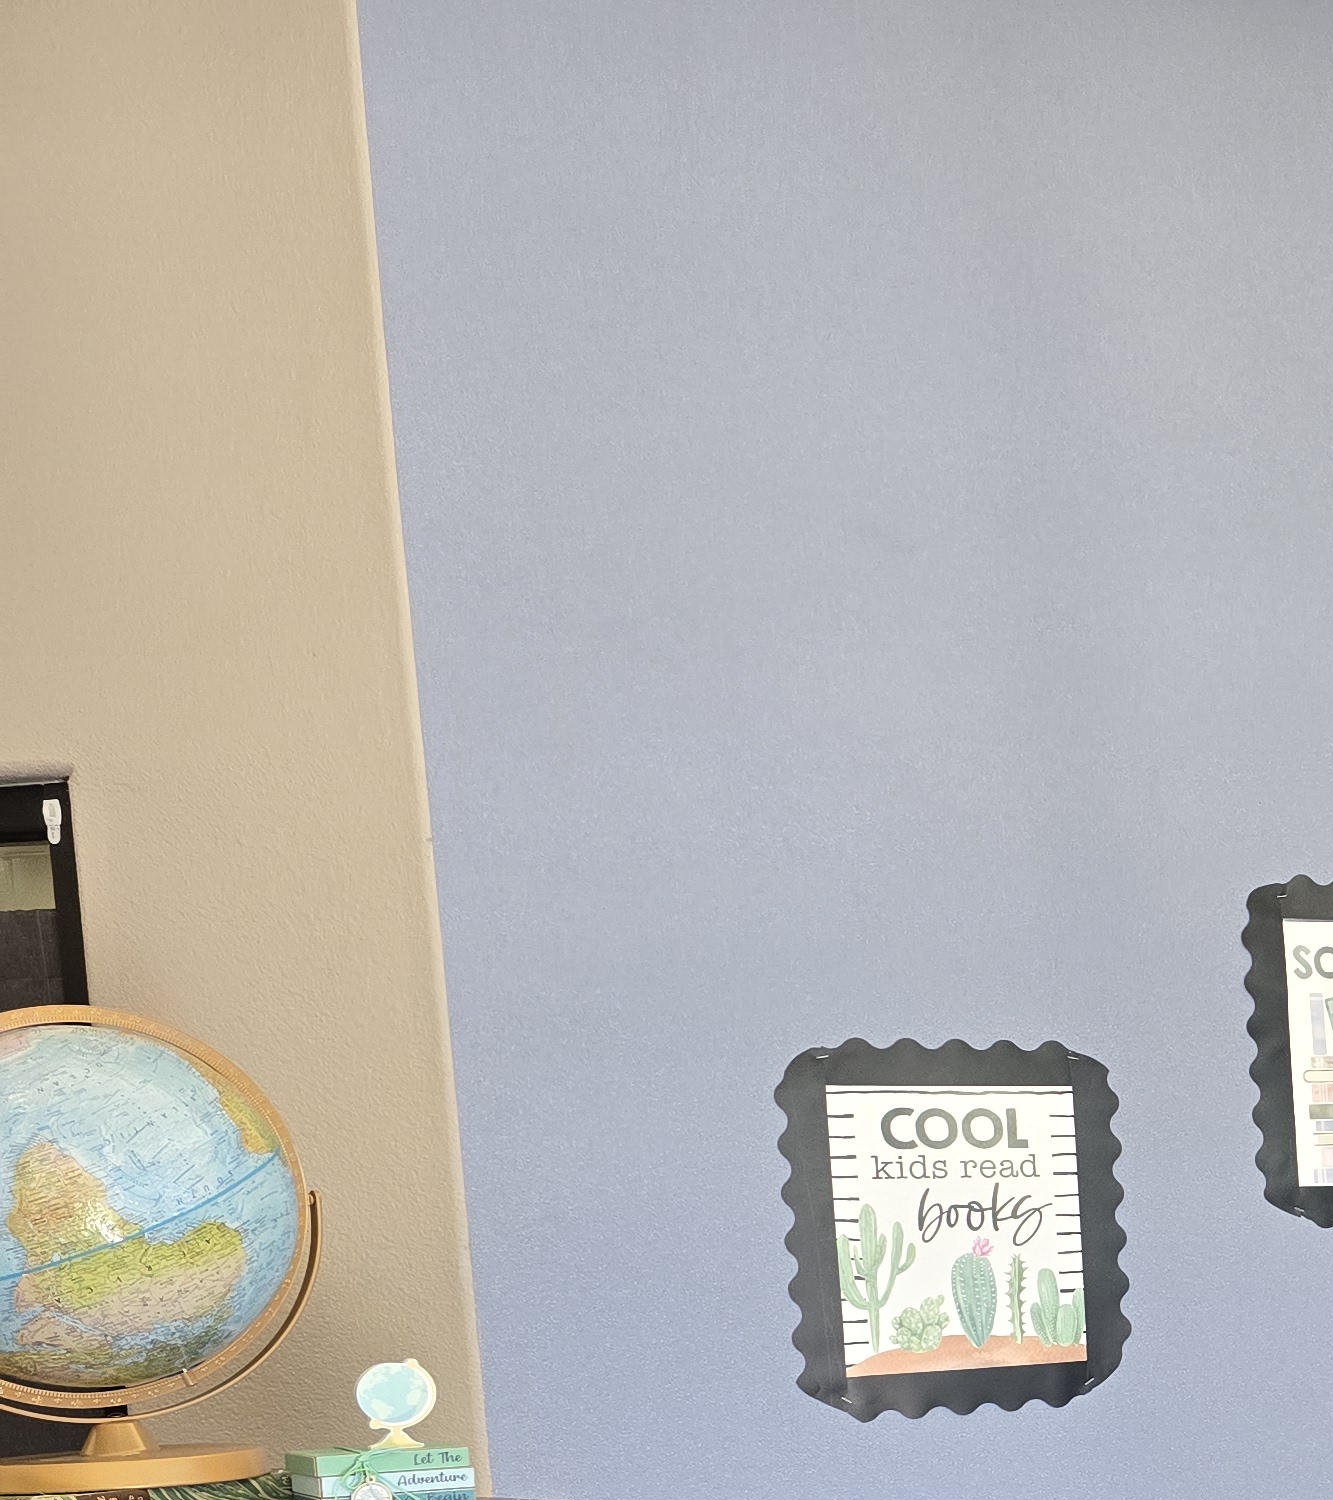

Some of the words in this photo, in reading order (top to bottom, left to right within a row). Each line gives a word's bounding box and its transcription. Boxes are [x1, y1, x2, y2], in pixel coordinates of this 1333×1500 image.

[881, 1107, 1029, 1149] COOL
[871, 1155, 948, 1180] kids
[960, 1154, 1041, 1179] read
[917, 1182, 1053, 1246] books
[413, 1452, 435, 1466] Let
[438, 1451, 463, 1464] The
[397, 1472, 469, 1487] Adventure
